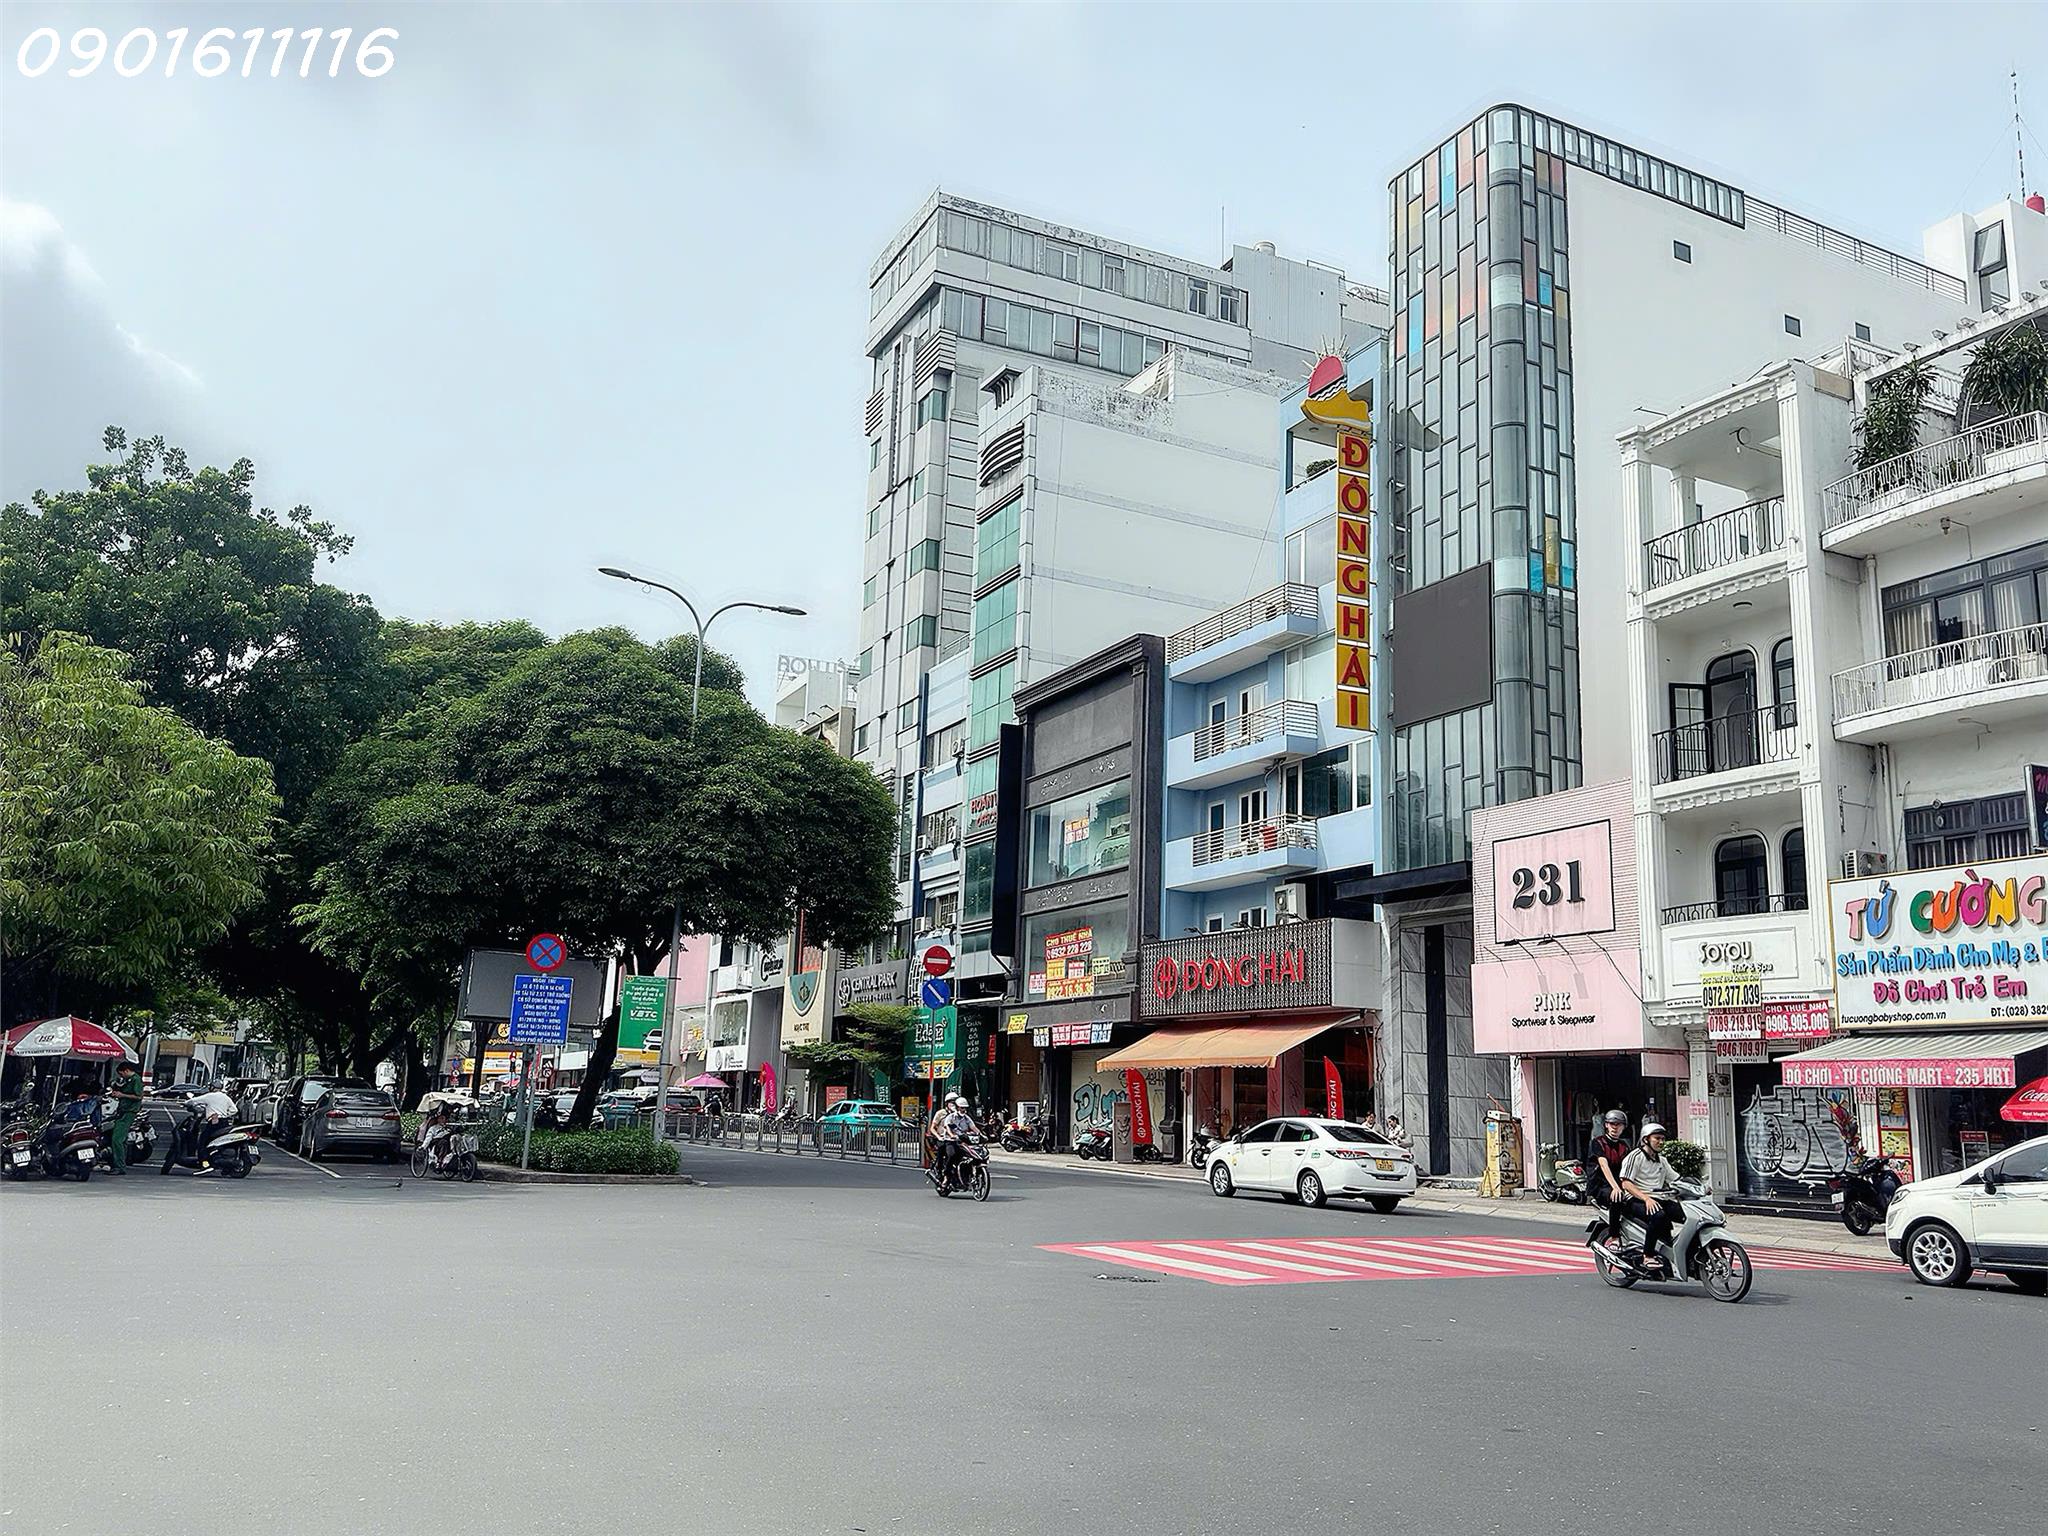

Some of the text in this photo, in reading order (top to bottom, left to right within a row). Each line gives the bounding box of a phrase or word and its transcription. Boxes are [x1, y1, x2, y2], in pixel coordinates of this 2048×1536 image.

[1340, 436, 1368, 726] ĐÔNG HẢI
[1512, 860, 1586, 910] 231
[1910, 868, 2048, 934] CƯỜNG
[1183, 941, 1304, 992] ĐÔNG HẢI
[1868, 945, 1912, 974] Phẩm
[1913, 944, 1956, 972] Dành
[1956, 942, 1991, 968] Cho
[1992, 940, 2020, 968] Mẹ
[2024, 942, 2040, 964] &
[852, 971, 898, 993] CENTRAL PARK
[1874, 974, 2028, 1004] Đồ Chơi Trẻ Em
[1534, 992, 1572, 1012] PINK
[1703, 984, 1760, 1007] 0972.377.039
[1766, 1006, 1783, 1014] CHO
[1784, 1002, 1806, 1012] THUÊ
[2030, 1004, 2048, 1016] 382
[1512, 1015, 1596, 1028] Sportwear & Sleepwear
[1709, 1014, 1762, 1032] 0789.219.919
[1766, 1012, 1829, 1032] 0906.905.006
[1717, 1042, 1768, 1057] 0946.709.977
[1805, 1067, 1832, 1085] CHƠI
[1861, 1064, 1902, 1085] CƯỜNG
[1906, 1067, 1943, 1085] MART
[1955, 1068, 1979, 1085] 235
[1984, 1067, 2010, 1086] HBT
